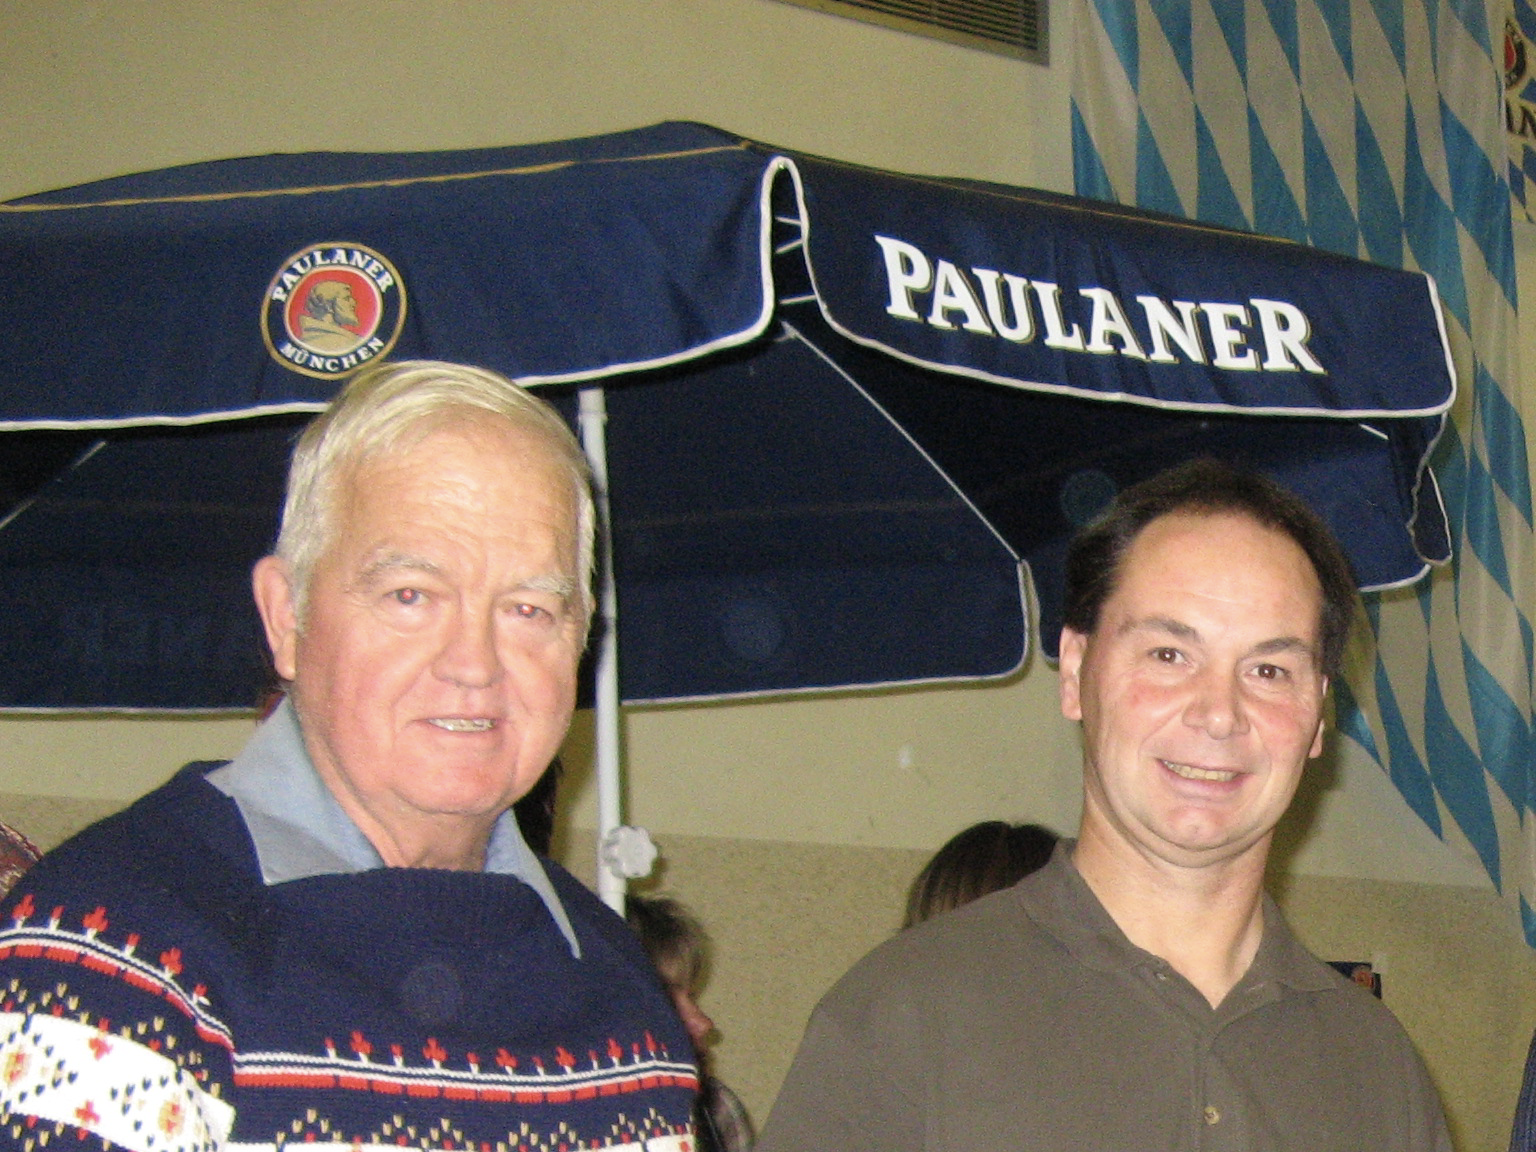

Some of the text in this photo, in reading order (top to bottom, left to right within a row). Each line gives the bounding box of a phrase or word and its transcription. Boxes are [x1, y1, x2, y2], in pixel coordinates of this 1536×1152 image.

[272, 249, 394, 303] PAULANER
[874, 234, 1327, 374] PAULANER
[279, 337, 385, 372] MÜNCHEN
